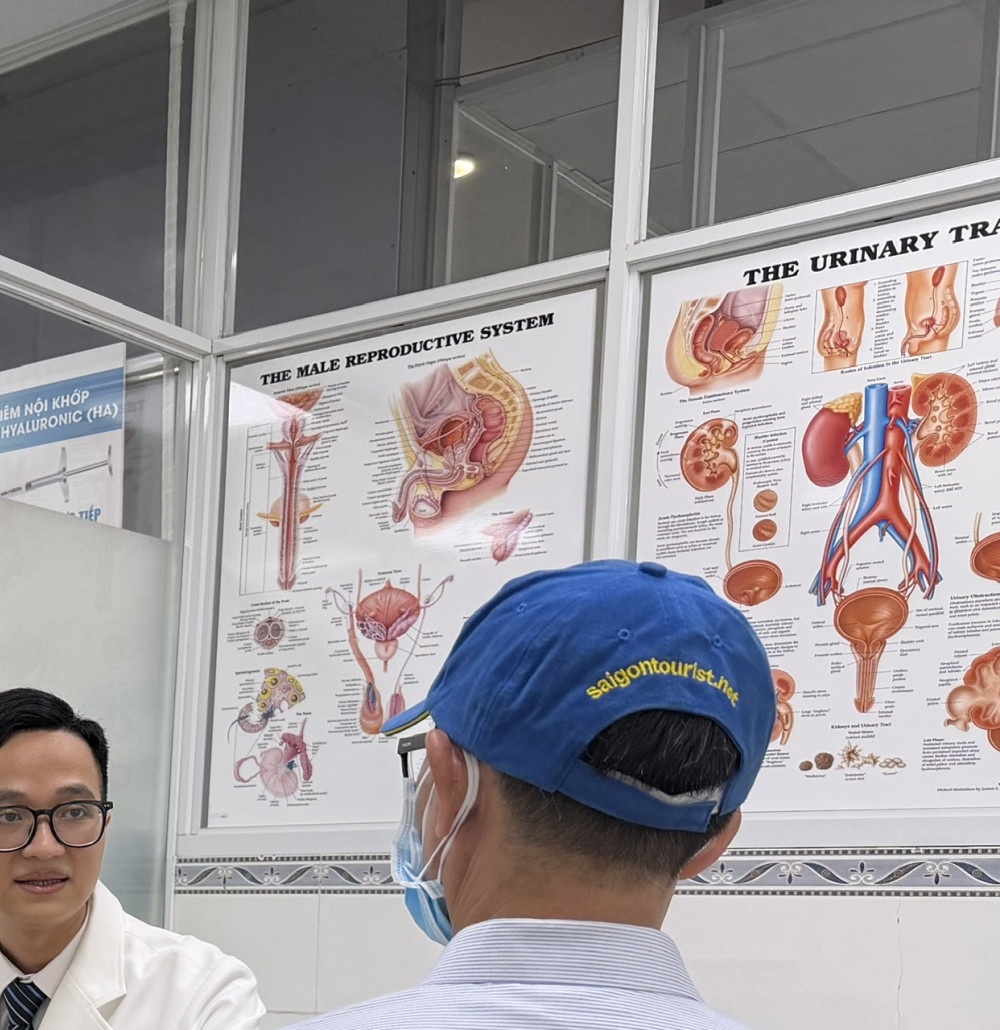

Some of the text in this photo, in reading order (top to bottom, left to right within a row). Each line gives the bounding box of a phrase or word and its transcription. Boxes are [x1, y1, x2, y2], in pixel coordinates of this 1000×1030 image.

[743, 261, 799, 286] THE
[810, 230, 939, 272] URINARY
[260, 370, 292, 386] THE
[296, 358, 340, 380] MALE
[345, 329, 474, 368] REPRODUCTIVE
[480, 312, 555, 341] SYSTEM
[1, 410, 83, 440] HYALURONIC
[87, 402, 118, 424] (HA)
[24, 399, 48, 417] NỘI
[52, 388, 90, 410] KHỚP
[586, 657, 739, 708] saigontourist.net
